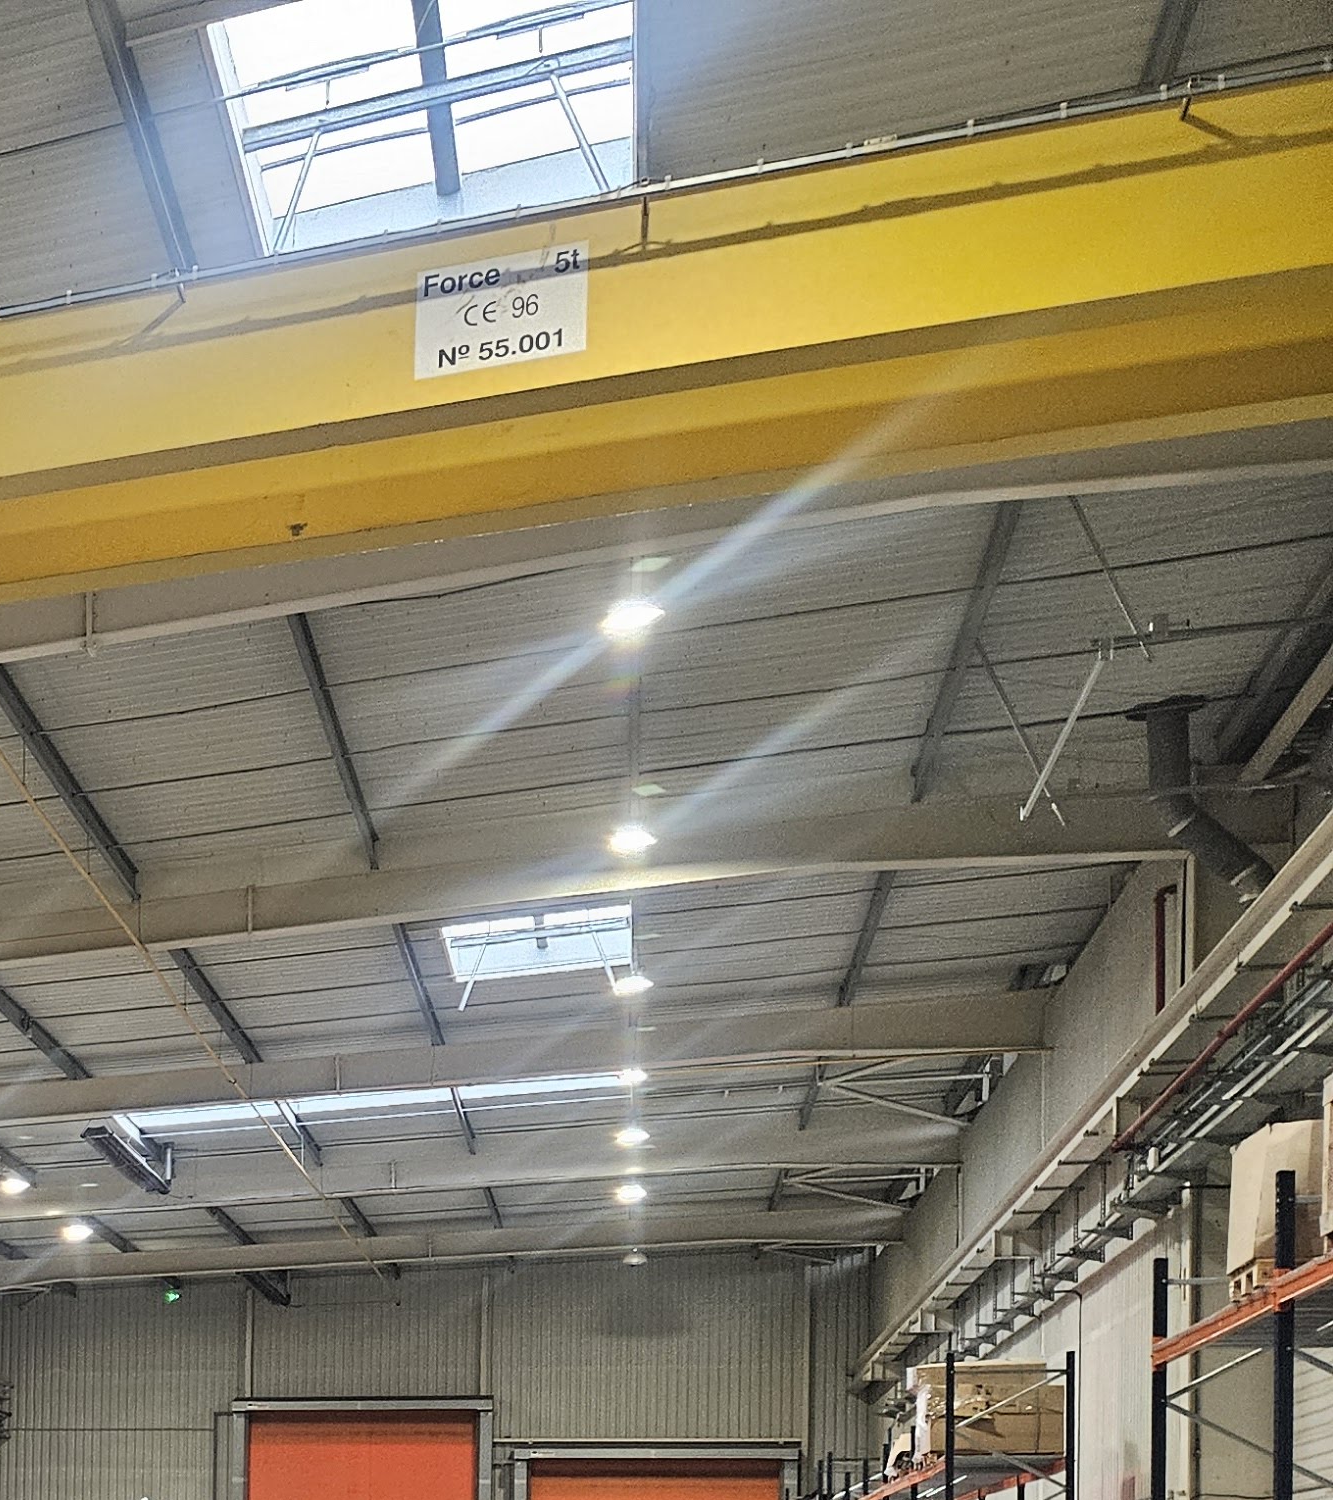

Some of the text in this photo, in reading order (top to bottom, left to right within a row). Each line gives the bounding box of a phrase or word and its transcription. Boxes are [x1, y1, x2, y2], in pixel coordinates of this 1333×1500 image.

[423, 249, 580, 297] Force 5t
[511, 294, 539, 319] 96
[478, 328, 564, 361] 55.001
